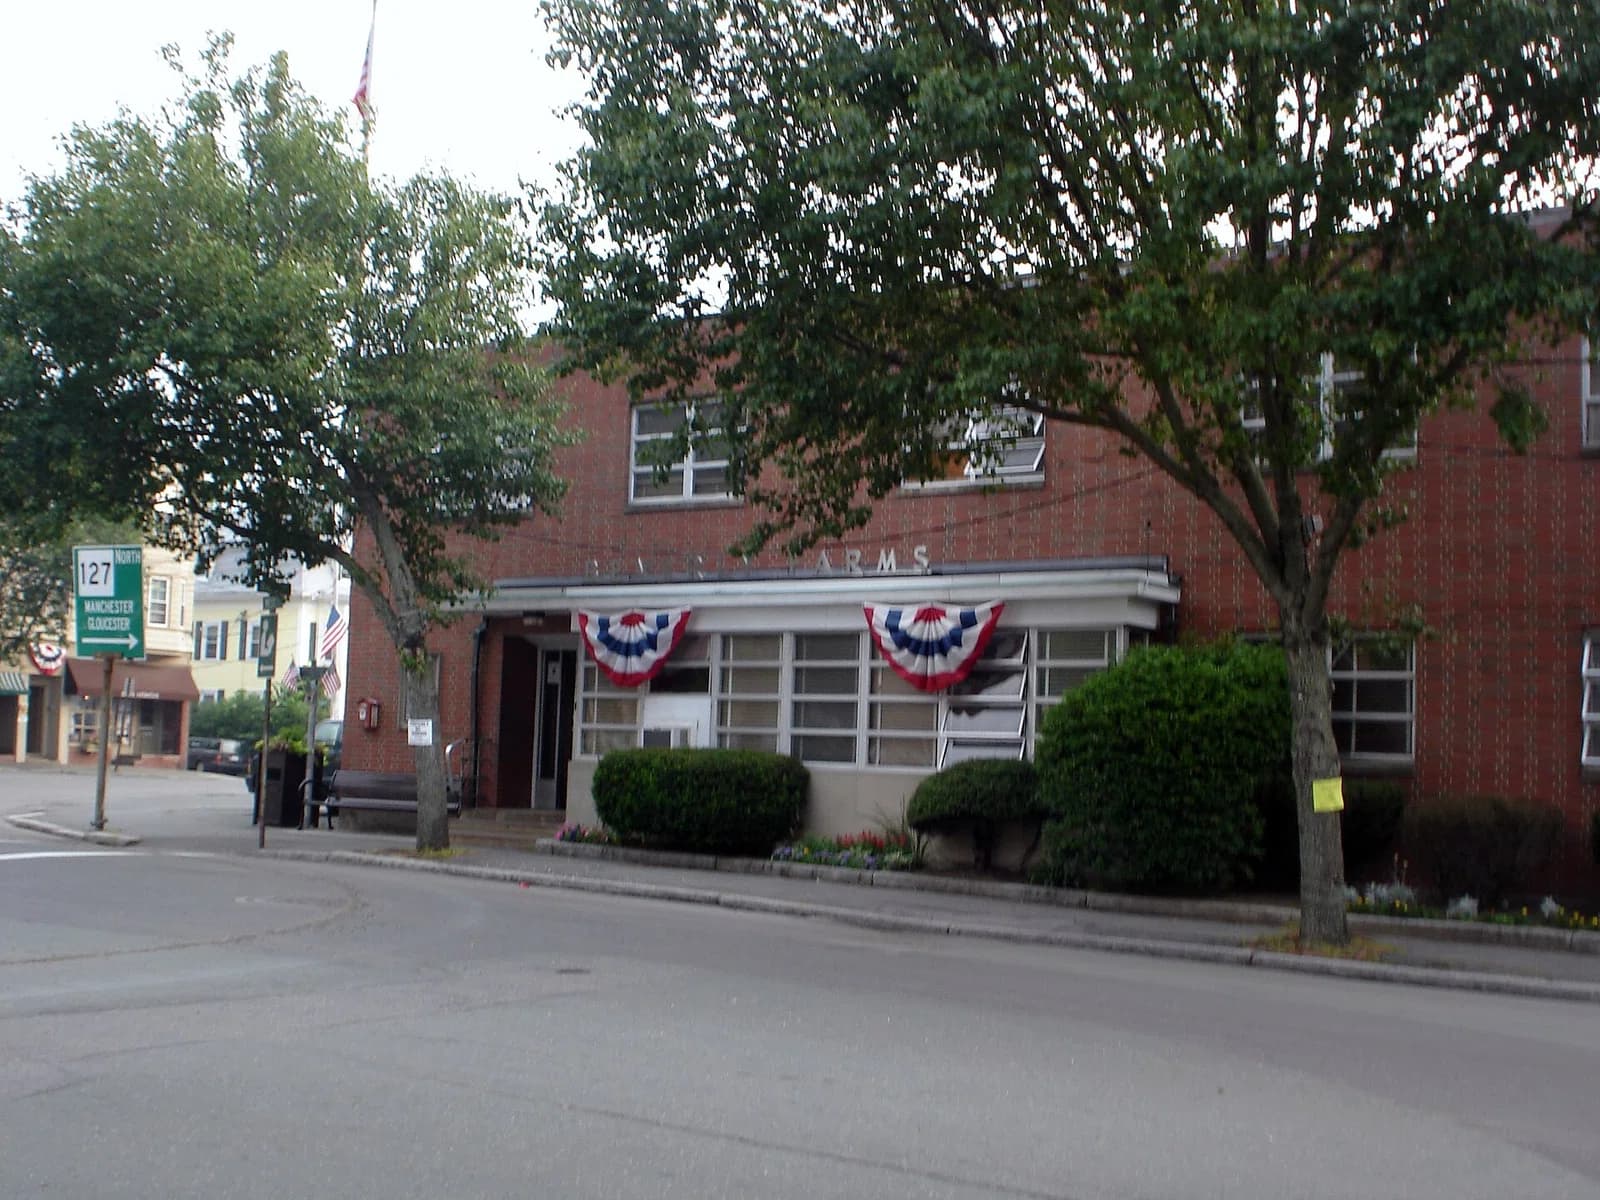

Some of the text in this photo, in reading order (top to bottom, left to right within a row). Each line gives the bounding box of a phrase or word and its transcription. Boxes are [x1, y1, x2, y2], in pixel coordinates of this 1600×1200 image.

[115, 550, 141, 564] NORTH
[80, 562, 111, 585] 127
[84, 600, 133, 614] MANCHESTER
[87, 617, 130, 631] GLOUCESTER
